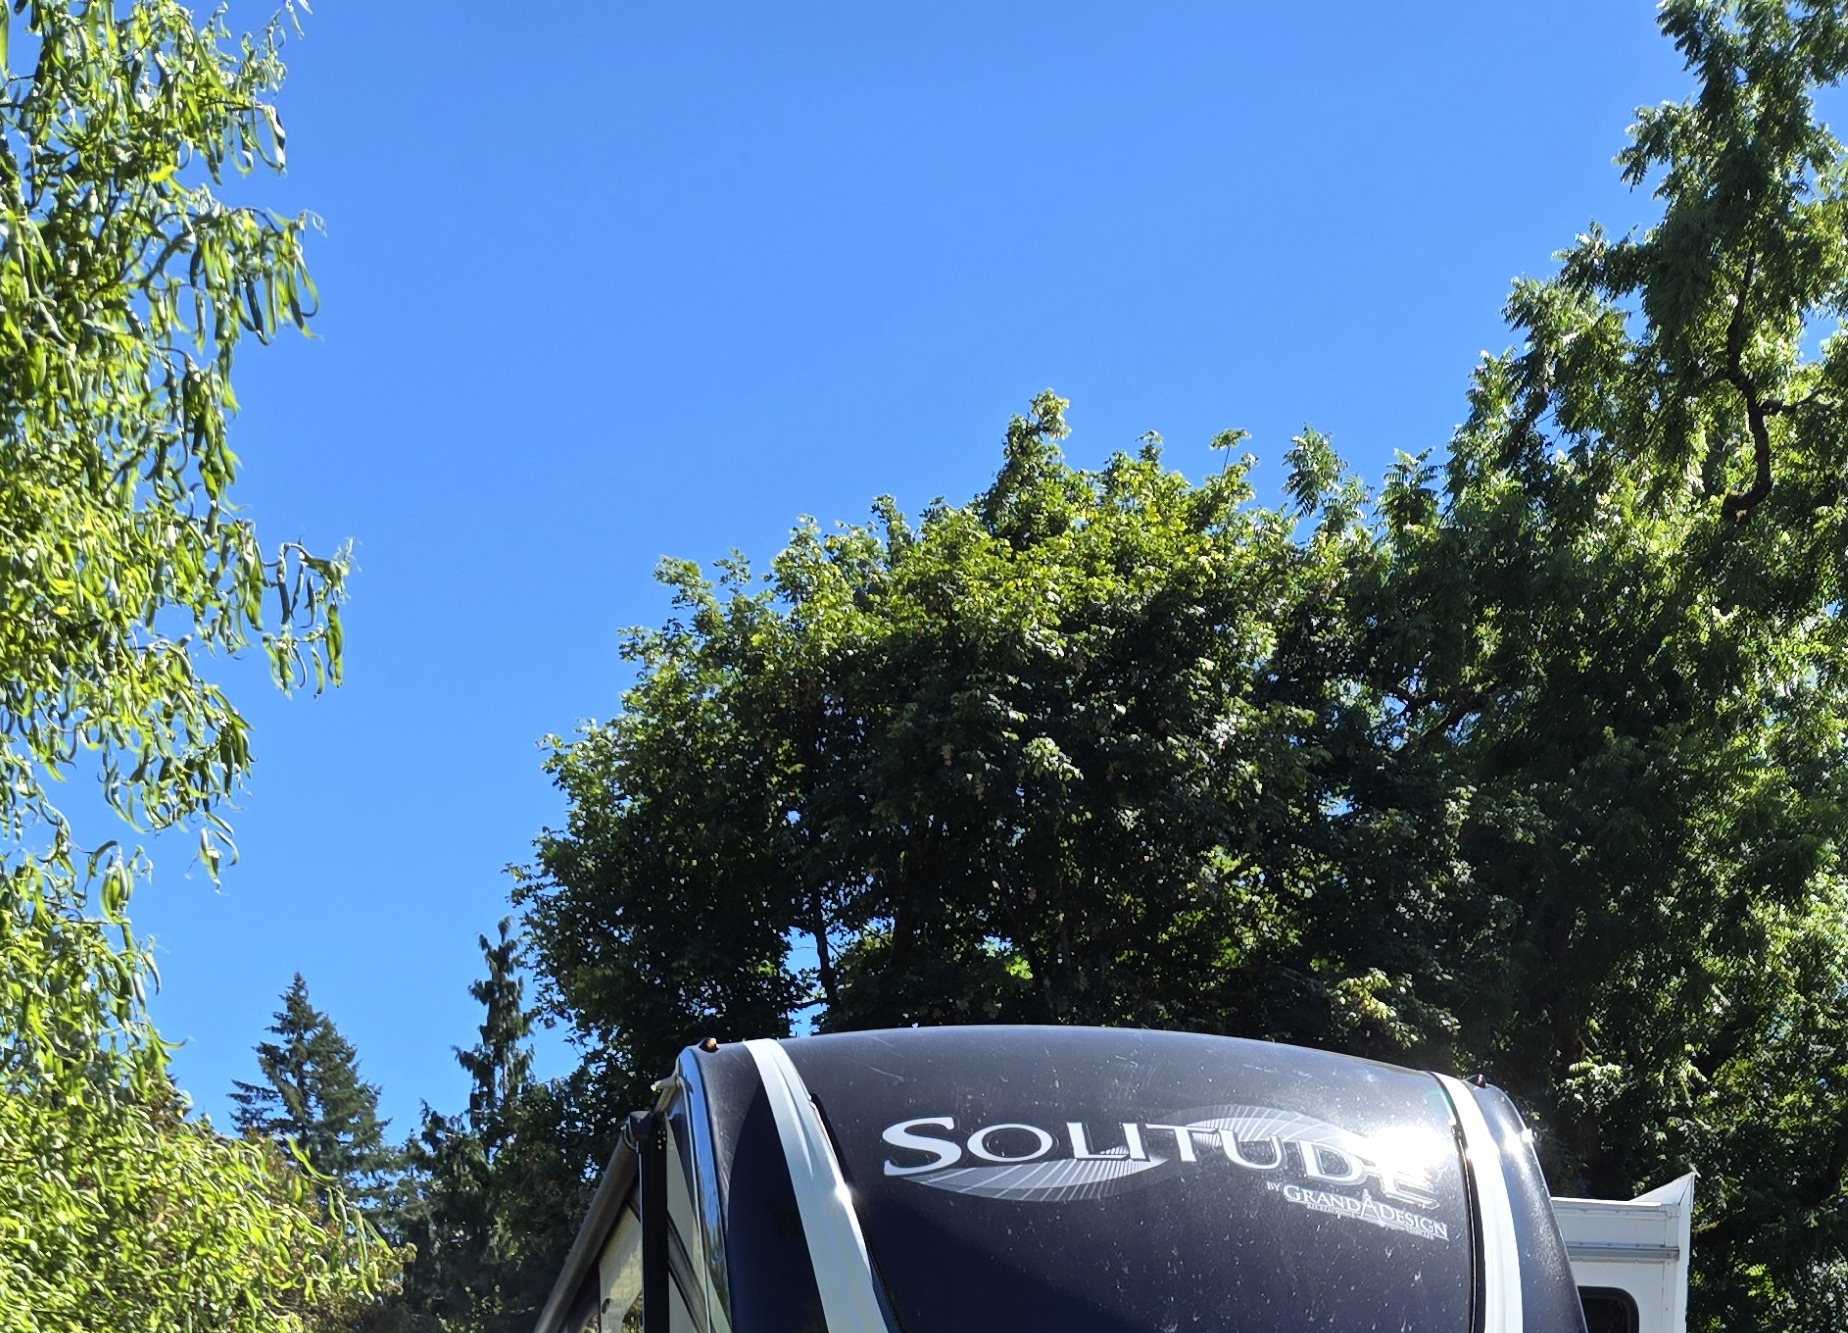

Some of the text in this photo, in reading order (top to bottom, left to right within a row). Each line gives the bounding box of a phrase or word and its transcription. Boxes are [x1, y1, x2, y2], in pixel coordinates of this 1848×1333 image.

[882, 1116, 1440, 1209] SOLITUDE
[1266, 1181, 1281, 1192] BY
[1283, 1184, 1361, 1213] GRAND
[1379, 1203, 1448, 1238] DESIGN
